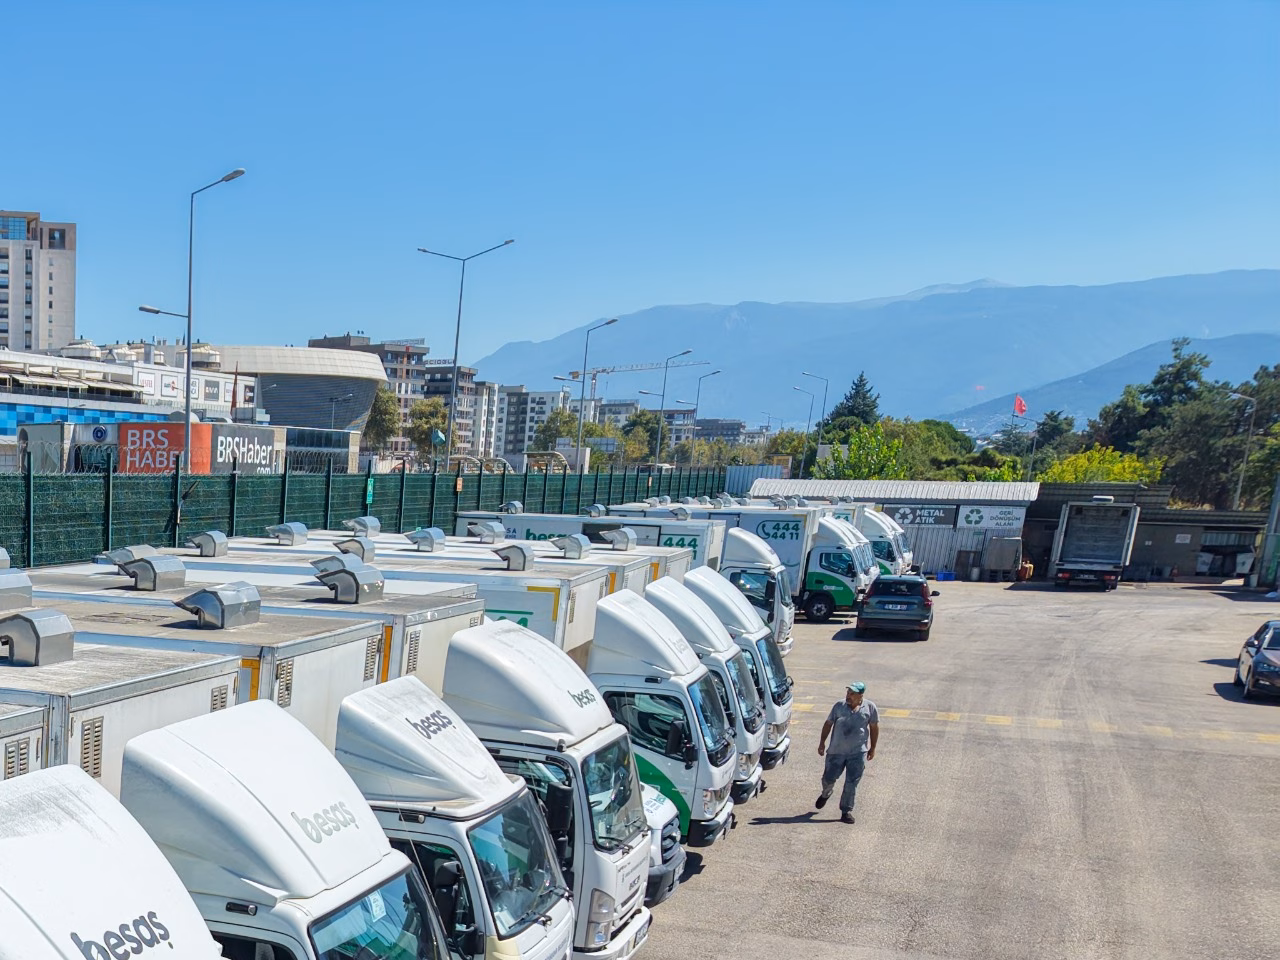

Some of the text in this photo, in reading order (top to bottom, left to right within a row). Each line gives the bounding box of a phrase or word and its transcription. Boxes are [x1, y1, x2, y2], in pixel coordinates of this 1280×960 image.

[127, 429, 169, 449] BRS
[916, 508, 945, 517] METAL
[915, 516, 935, 524] ATIK
[772, 522, 800, 532] 444
[771, 531, 800, 541] 44 11
[663, 536, 699, 549] 444
[405, 709, 457, 740] besaş
[290, 801, 360, 844] besaş
